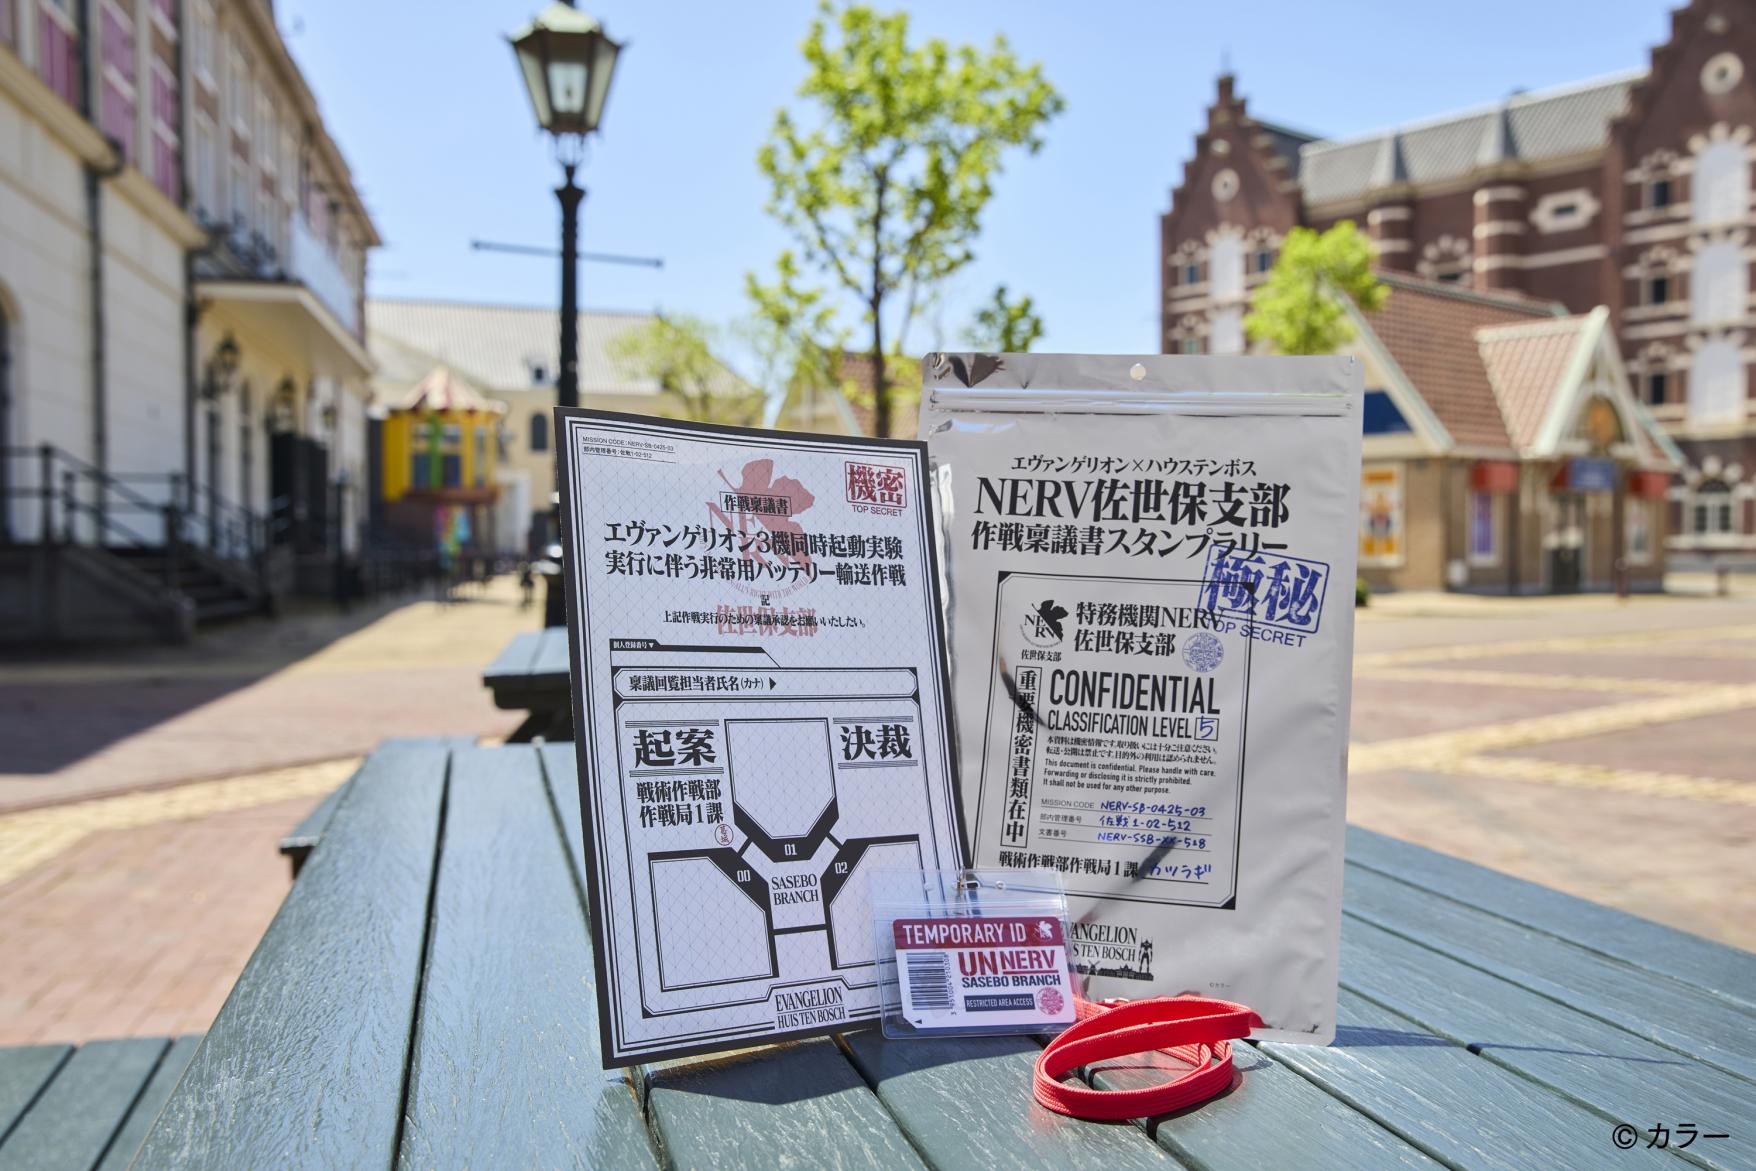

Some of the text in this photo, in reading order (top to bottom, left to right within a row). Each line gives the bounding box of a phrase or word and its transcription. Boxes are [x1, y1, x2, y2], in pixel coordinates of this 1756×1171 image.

[1011, 454, 1257, 477] エヴァンゲリオン×ハウステンボス
[848, 464, 904, 506] 機密
[724, 494, 788, 515] 作戦稟議書
[852, 505, 903, 517] TOP SECRET
[973, 476, 1291, 528] NERV佐世保支部
[604, 520, 904, 560] エヴァンゲリオン3機同時起動実験
[971, 520, 1288, 561] 作戦稟議書スタンプラリー
[605, 550, 907, 587] 実行に伴う非常用バッテリー輸送作戦
[1204, 549, 1322, 626] 極秘
[760, 594, 770, 606] 記
[1075, 601, 1224, 631] 特務機関NERV
[1074, 629, 1176, 657] 佐世保支部
[1240, 624, 1307, 648] SECRET
[1021, 649, 1062, 662] 佐世保支部
[1050, 669, 1220, 715] CONFIDENTIAL
[1048, 709, 1215, 739] CLASSIFICATION LEVEL 5
[633, 728, 717, 769] 起案
[840, 724, 913, 761] 決裁
[1044, 768, 1079, 779] Forwarding
[1089, 772, 1120, 782] disclosing
[1135, 775, 1157, 785] strictly
[1159, 777, 1192, 785] prohibited.
[1045, 758, 1058, 767] This
[1059, 760, 1089, 769] document
[1098, 763, 1136, 772] confidential.
[1139, 765, 1160, 774] Please
[1162, 766, 1182, 775] handle
[1184, 768, 1198, 776] with
[636, 779, 722, 804] 戦術作戦部
[1049, 779, 1064, 787] shall
[1103, 782, 1111, 790] for
[1113, 784, 1124, 792] any
[1126, 785, 1142, 793] other
[1041, 798, 1095, 809] MISSION CODE
[1100, 800, 1206, 817] NERV-SB-0425-03
[639, 802, 725, 829] 作戦局1課
[784, 843, 798, 856] 01
[834, 861, 849, 875] 02
[999, 850, 1139, 878] 戦術作戦部作戦局1課
[736, 869, 752, 883] 00
[771, 873, 818, 891] SASEBO
[773, 889, 820, 906] BRANCH
[902, 923, 1004, 945] TEMPORARY
[1010, 922, 1027, 943] ID
[957, 950, 999, 977] UN
[1000, 949, 1056, 970] NERV
[1081, 944, 1099, 958] TEN
[1102, 946, 1136, 962] BOSCH
[961, 974, 1062, 989] SASEBO BRANCH
[775, 986, 843, 1012] EVANGELION
[966, 997, 1034, 1008] RESTRICTED AREA ACCESS
[777, 1006, 847, 1030] HUIS TEN BOSCH
